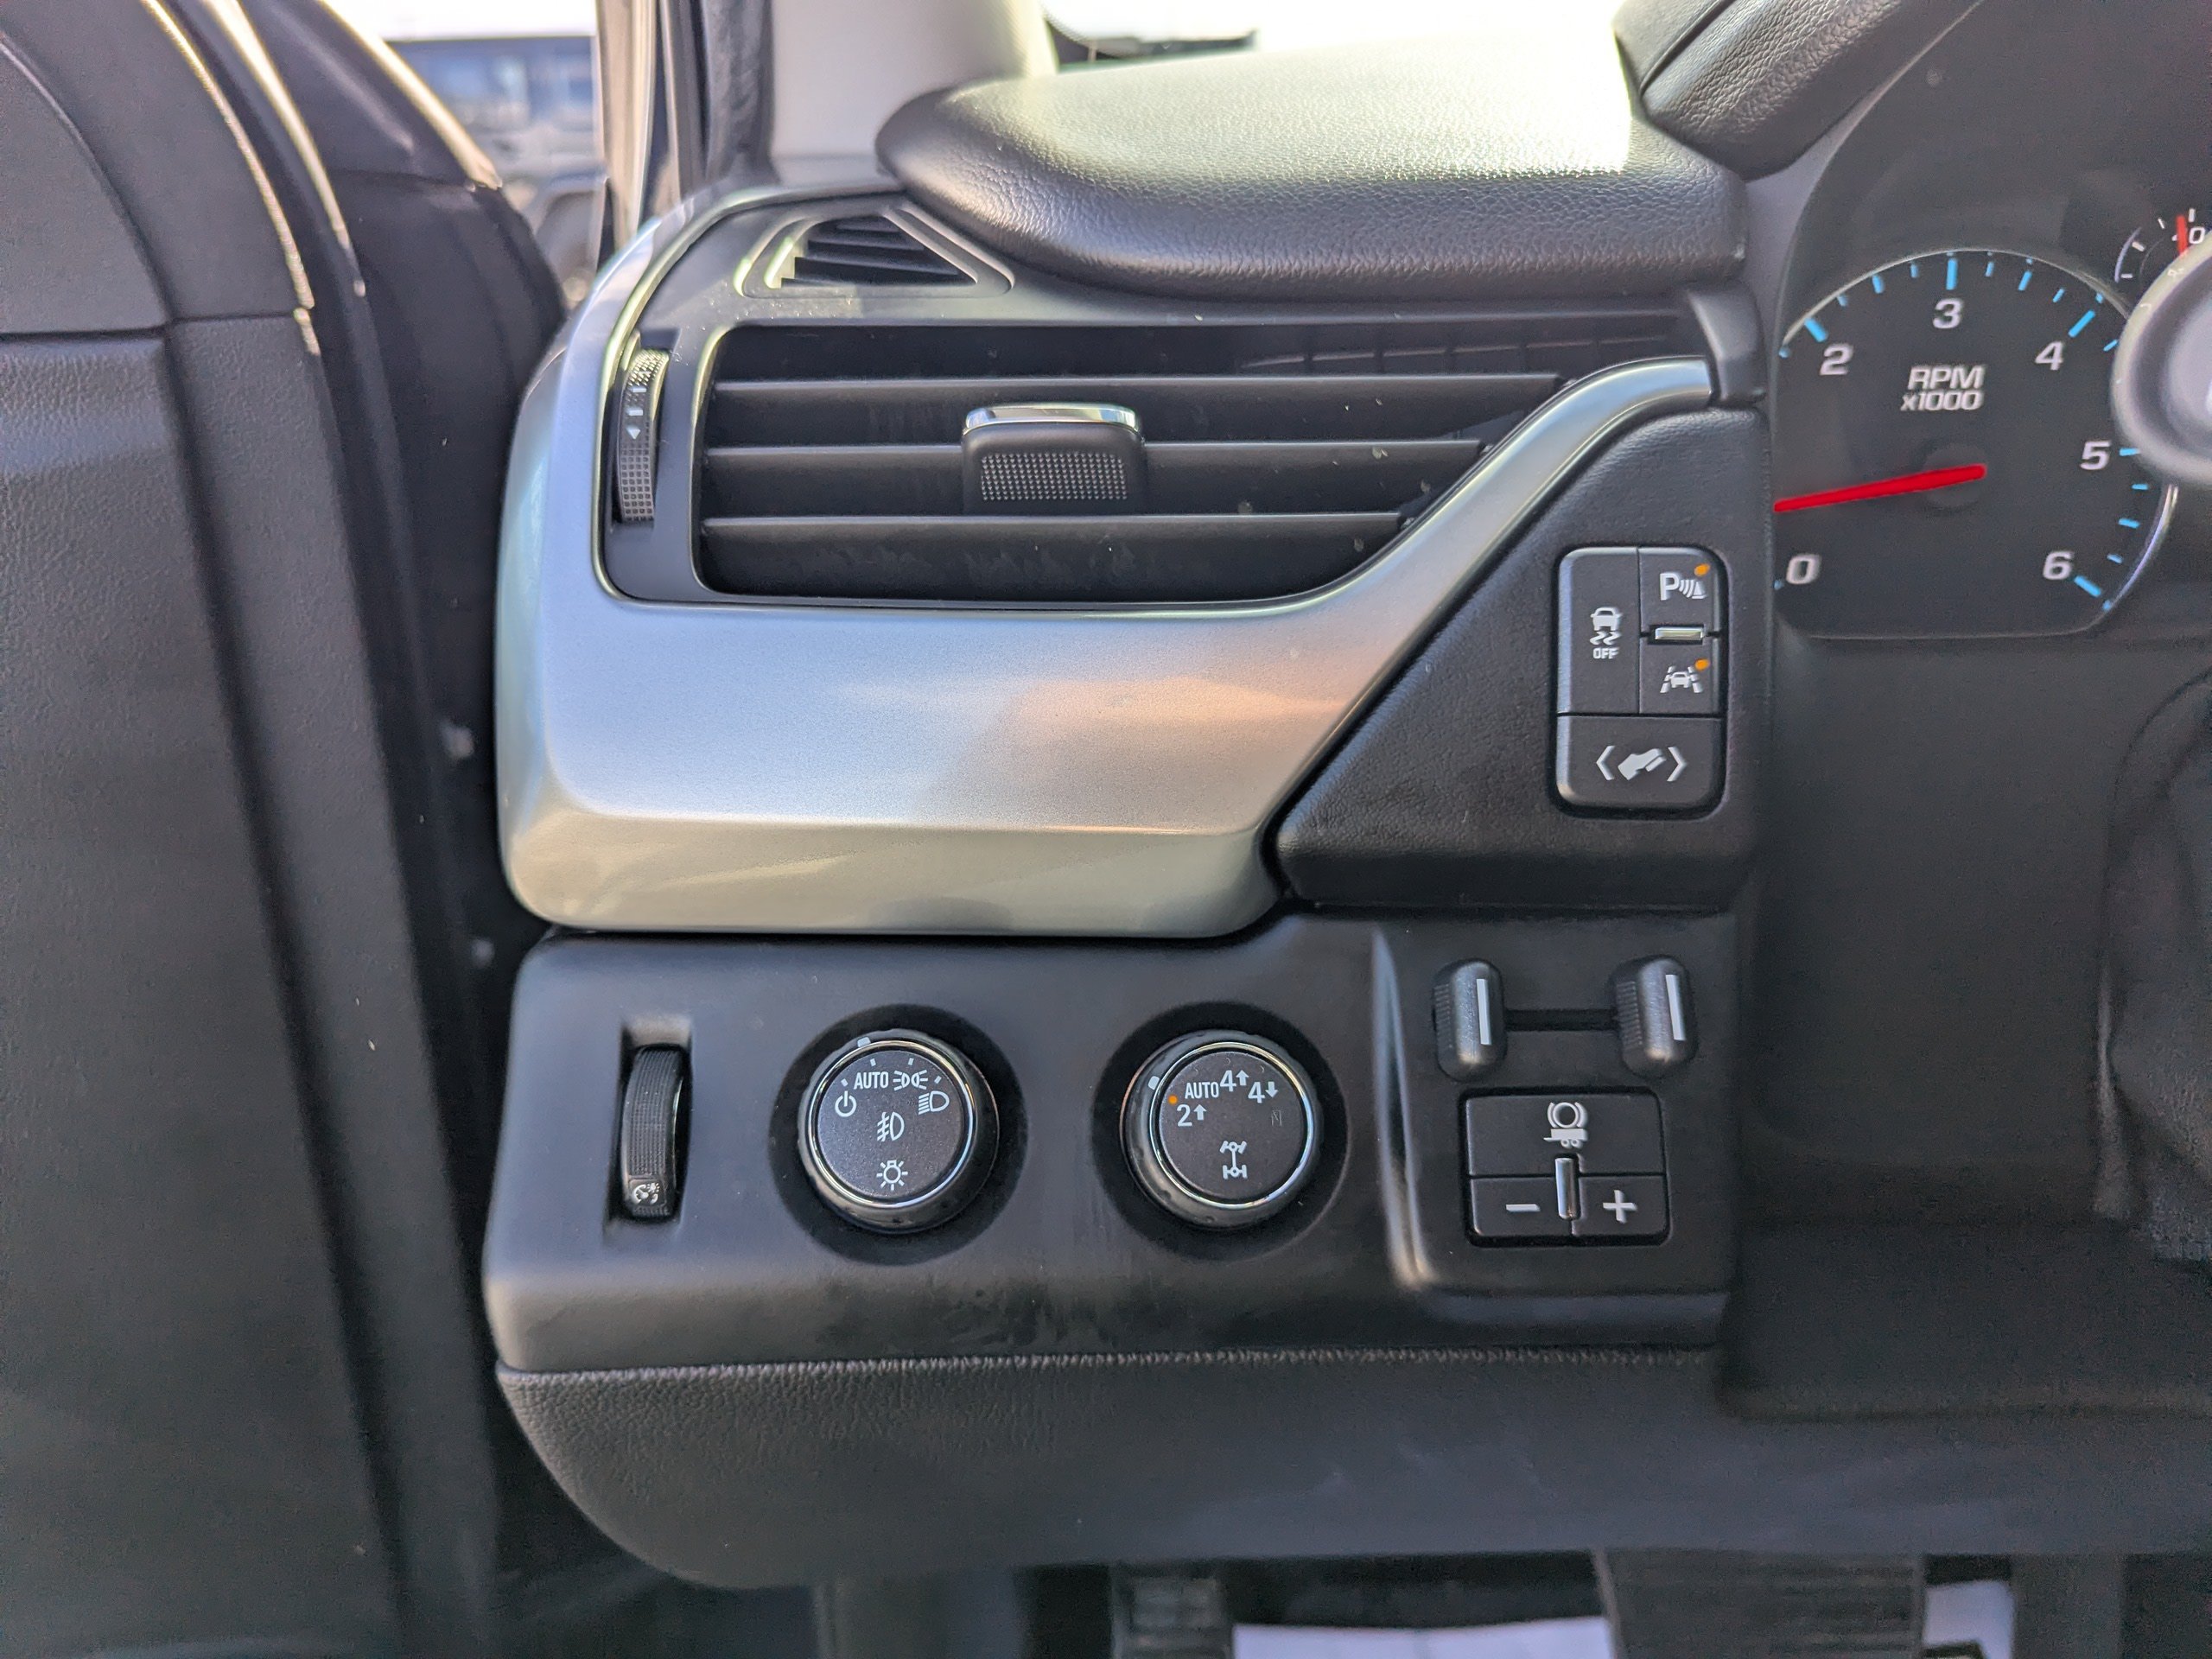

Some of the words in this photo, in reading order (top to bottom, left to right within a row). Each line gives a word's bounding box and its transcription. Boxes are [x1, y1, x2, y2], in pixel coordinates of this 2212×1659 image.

[1932, 298, 1963, 329] 3
[1820, 344, 1853, 376] 2
[2035, 342, 2064, 371] 4
[1907, 365, 1985, 391] RPM
[2081, 441, 2111, 471] 5
[1786, 554, 1821, 585] 0
[2042, 551, 2075, 581] 6
[1659, 572, 1680, 601] P
[1592, 647, 1619, 659] OFF
[854, 1071, 889, 1090] AUTO
[1185, 1081, 1219, 1100] AUTO
[1219, 1070, 1236, 1092] 4
[1248, 1082, 1265, 1103] 4
[1176, 1103, 1193, 1127] 2
